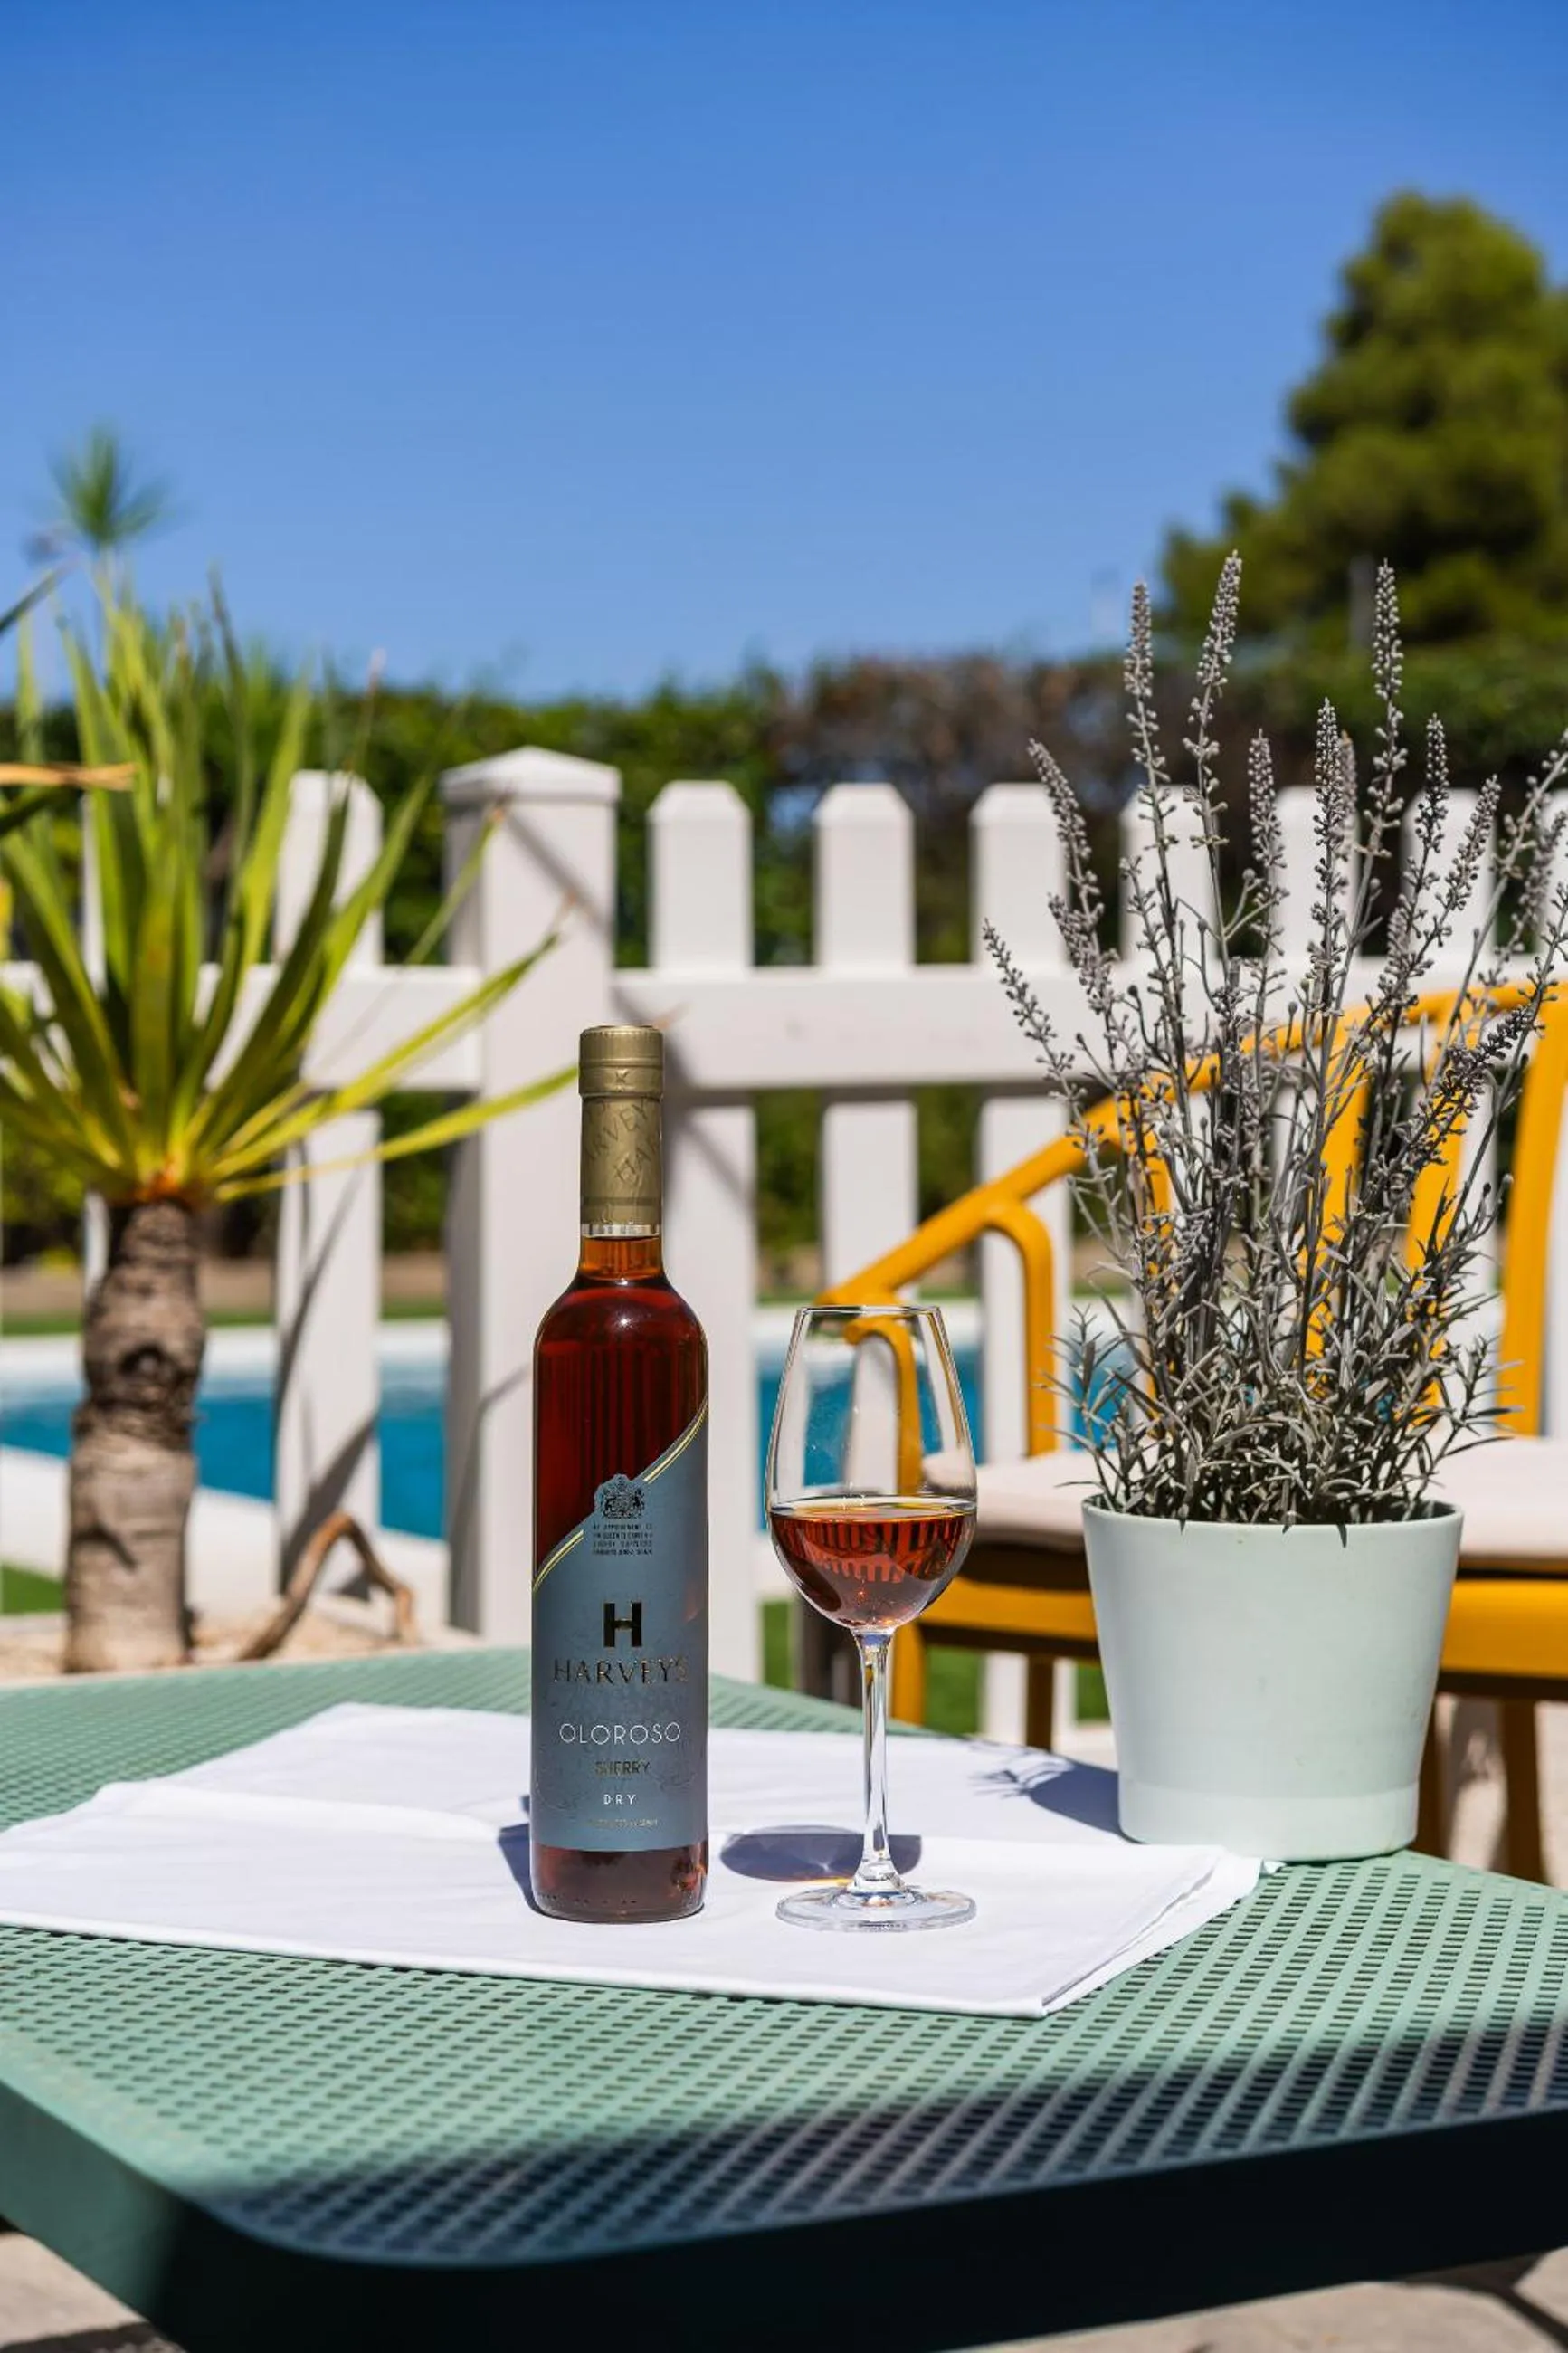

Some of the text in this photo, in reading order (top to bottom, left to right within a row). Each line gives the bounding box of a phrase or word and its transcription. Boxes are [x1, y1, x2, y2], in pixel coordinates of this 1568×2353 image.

[603, 1602, 642, 1647] H
[554, 1658, 689, 1685] HARVEYS
[559, 1721, 681, 1746] OLOROSO
[595, 1760, 651, 1775] SHERRY
[603, 1794, 637, 1805] DRY
